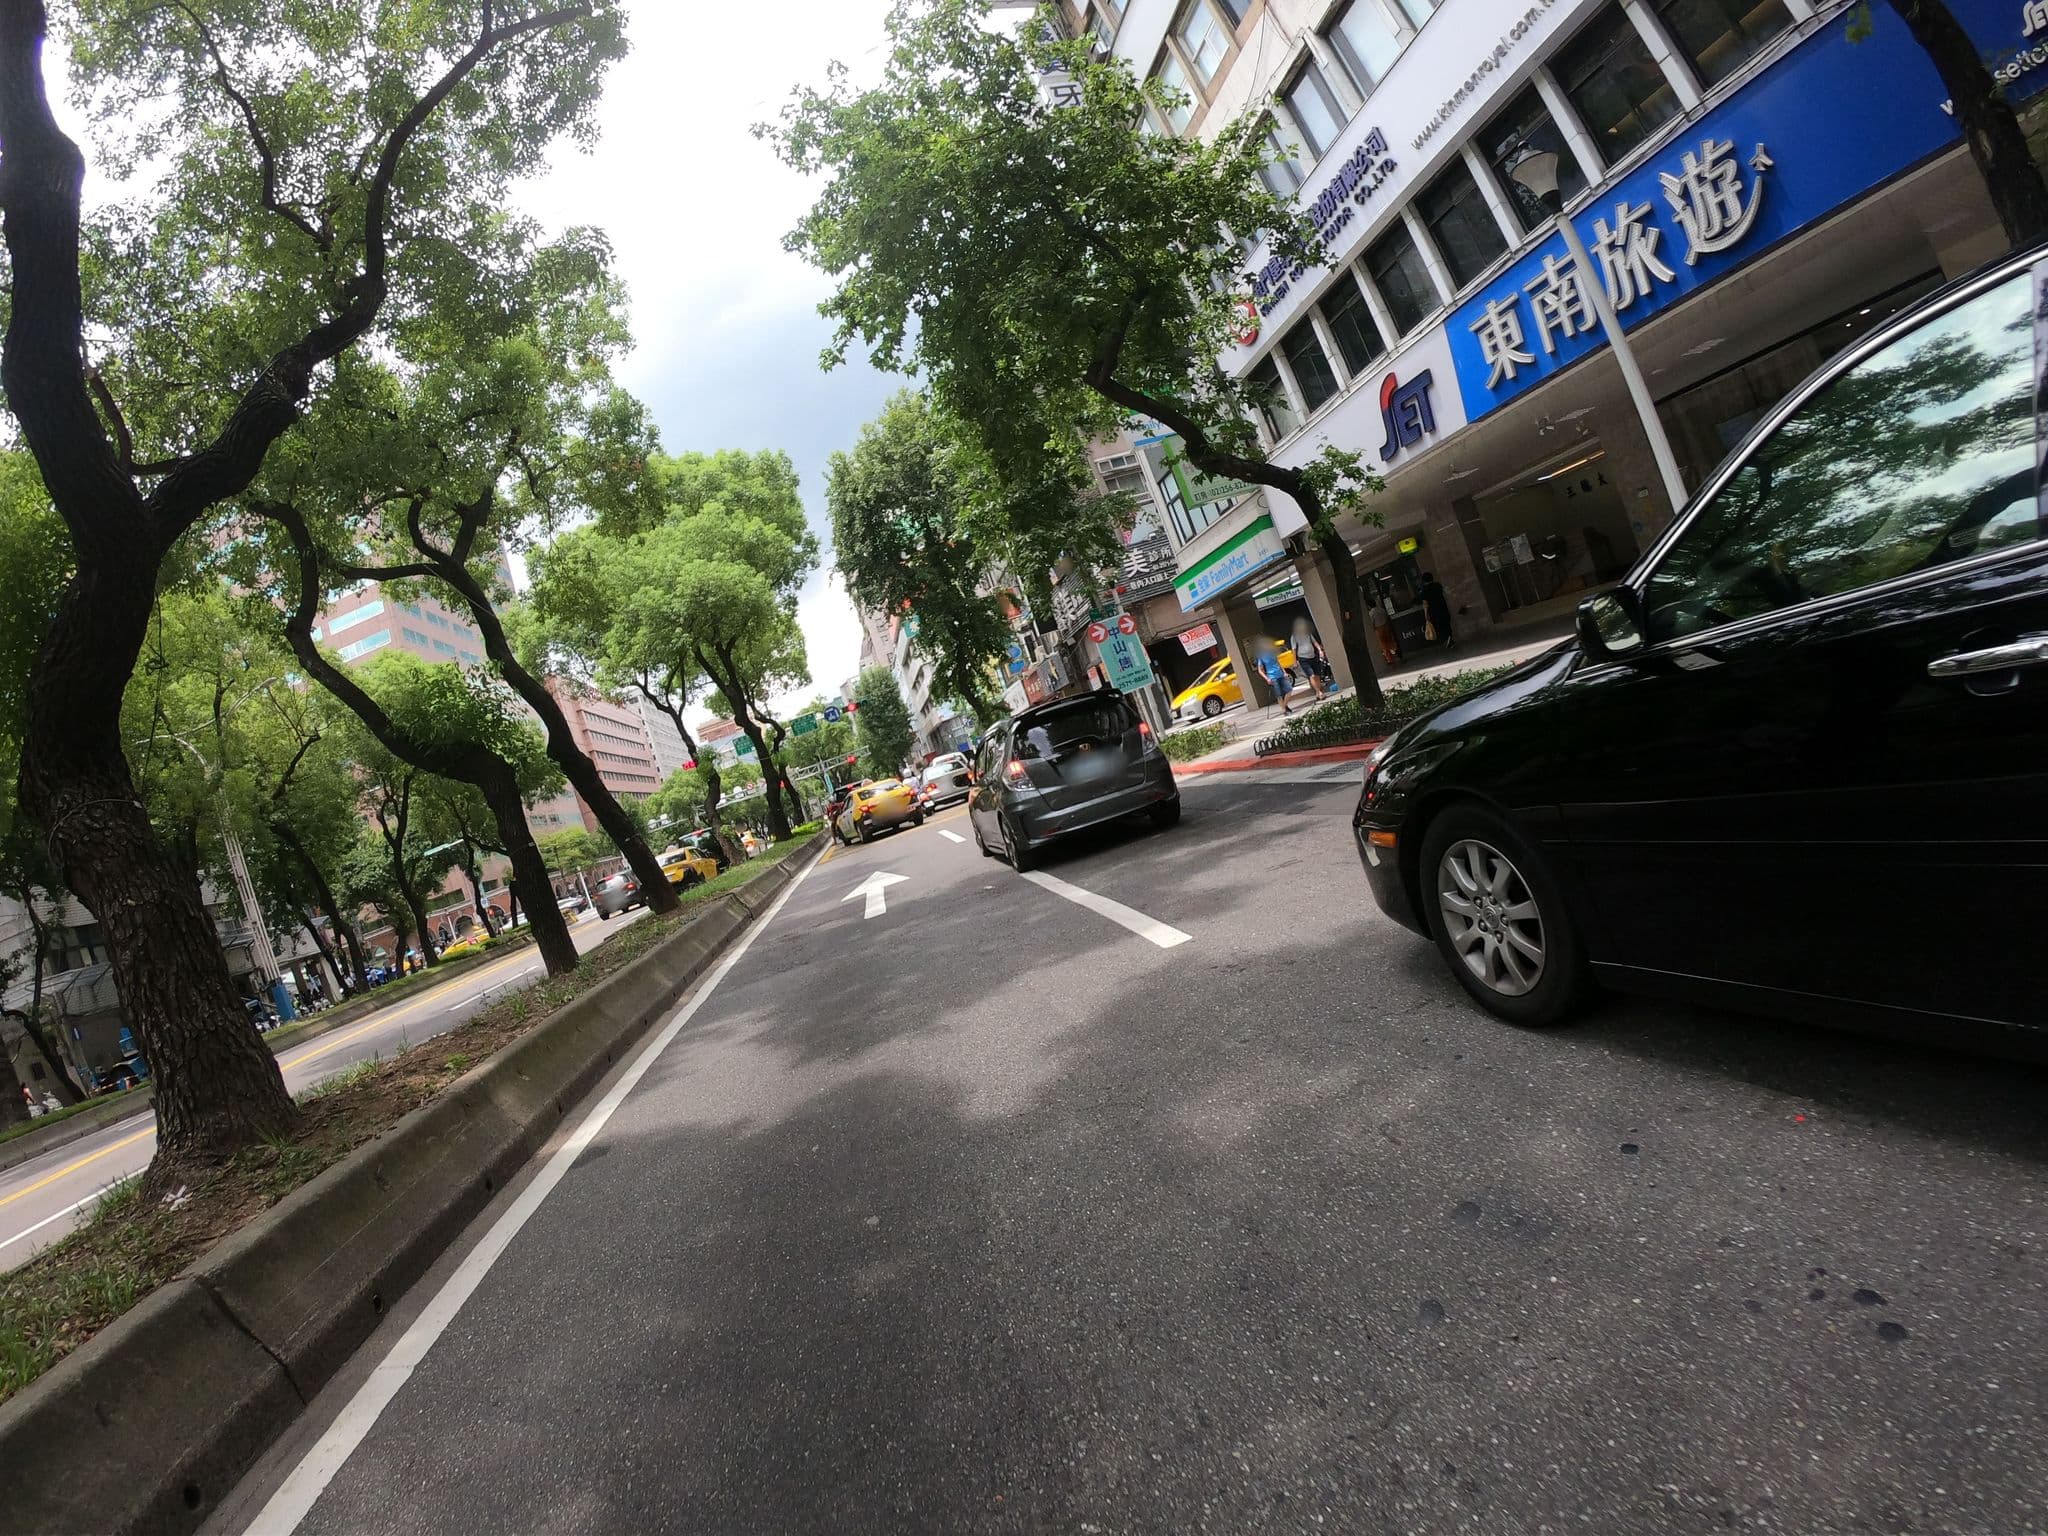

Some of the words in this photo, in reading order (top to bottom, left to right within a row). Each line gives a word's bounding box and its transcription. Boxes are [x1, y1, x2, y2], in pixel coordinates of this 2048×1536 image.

[1469, 138, 1765, 390] 東南旅遊
[1265, 588, 1302, 604] FamilyMart
